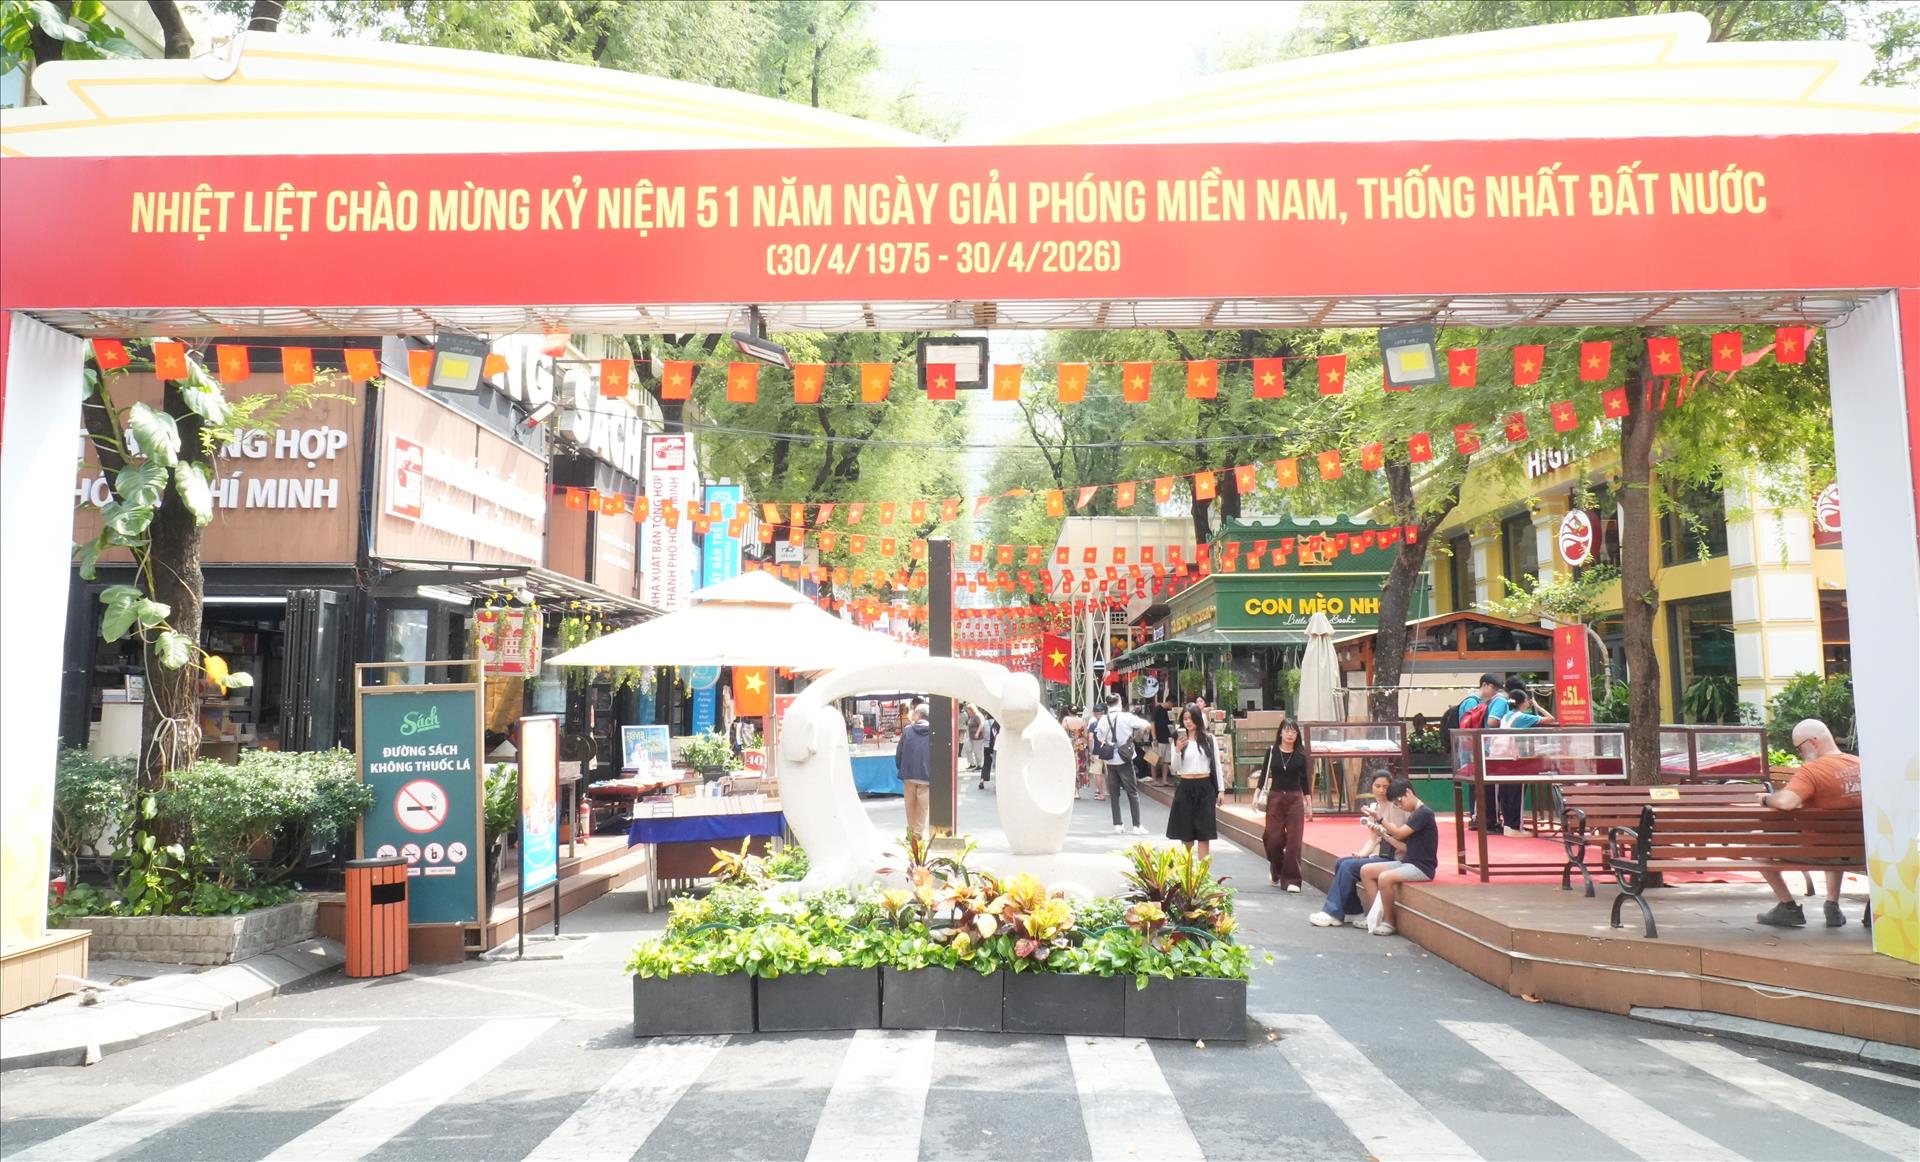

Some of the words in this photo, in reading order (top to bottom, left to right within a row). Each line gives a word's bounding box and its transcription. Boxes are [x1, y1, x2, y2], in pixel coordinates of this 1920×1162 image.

[131, 183, 235, 242] NHIỆT
[243, 183, 318, 241] LIỆT
[325, 181, 419, 233] CHÀO
[428, 180, 531, 232] MỪNG
[540, 174, 589, 231] KỶ
[597, 178, 686, 238] NIỆM
[695, 184, 740, 229] 51
[752, 175, 833, 228] NĂM
[843, 175, 936, 226] NGÀY
[948, 168, 1018, 225] GIẢI
[1029, 173, 1147, 224] PHÓNG
[1156, 166, 1247, 224] MIỀN
[1255, 178, 1349, 226] NAM,
[1355, 164, 1477, 221] THỐNG
[1484, 161, 1581, 219] NHẤT
[1588, 160, 1660, 217] ĐẤT
[1668, 163, 1768, 216] NƯỚC
[765, 242, 931, 277] (30/4/1975
[955, 239, 1122, 275] 30/4/2026)
[275, 426, 348, 469] HỢP
[245, 478, 339, 509] MINH
[1244, 598, 1292, 615] CON
[1298, 592, 1344, 615] MÈO
[1350, 597, 1380, 615] NH
[1567, 686, 1579, 706] 51
[400, 706, 440, 736] Sách
[370, 760, 413, 774] KHÔNG
[415, 757, 454, 772] THUỐC
[456, 758, 471, 771] LÁ
[383, 744, 426, 758] ĐƯỜNG
[429, 743, 458, 756] SÁCH
